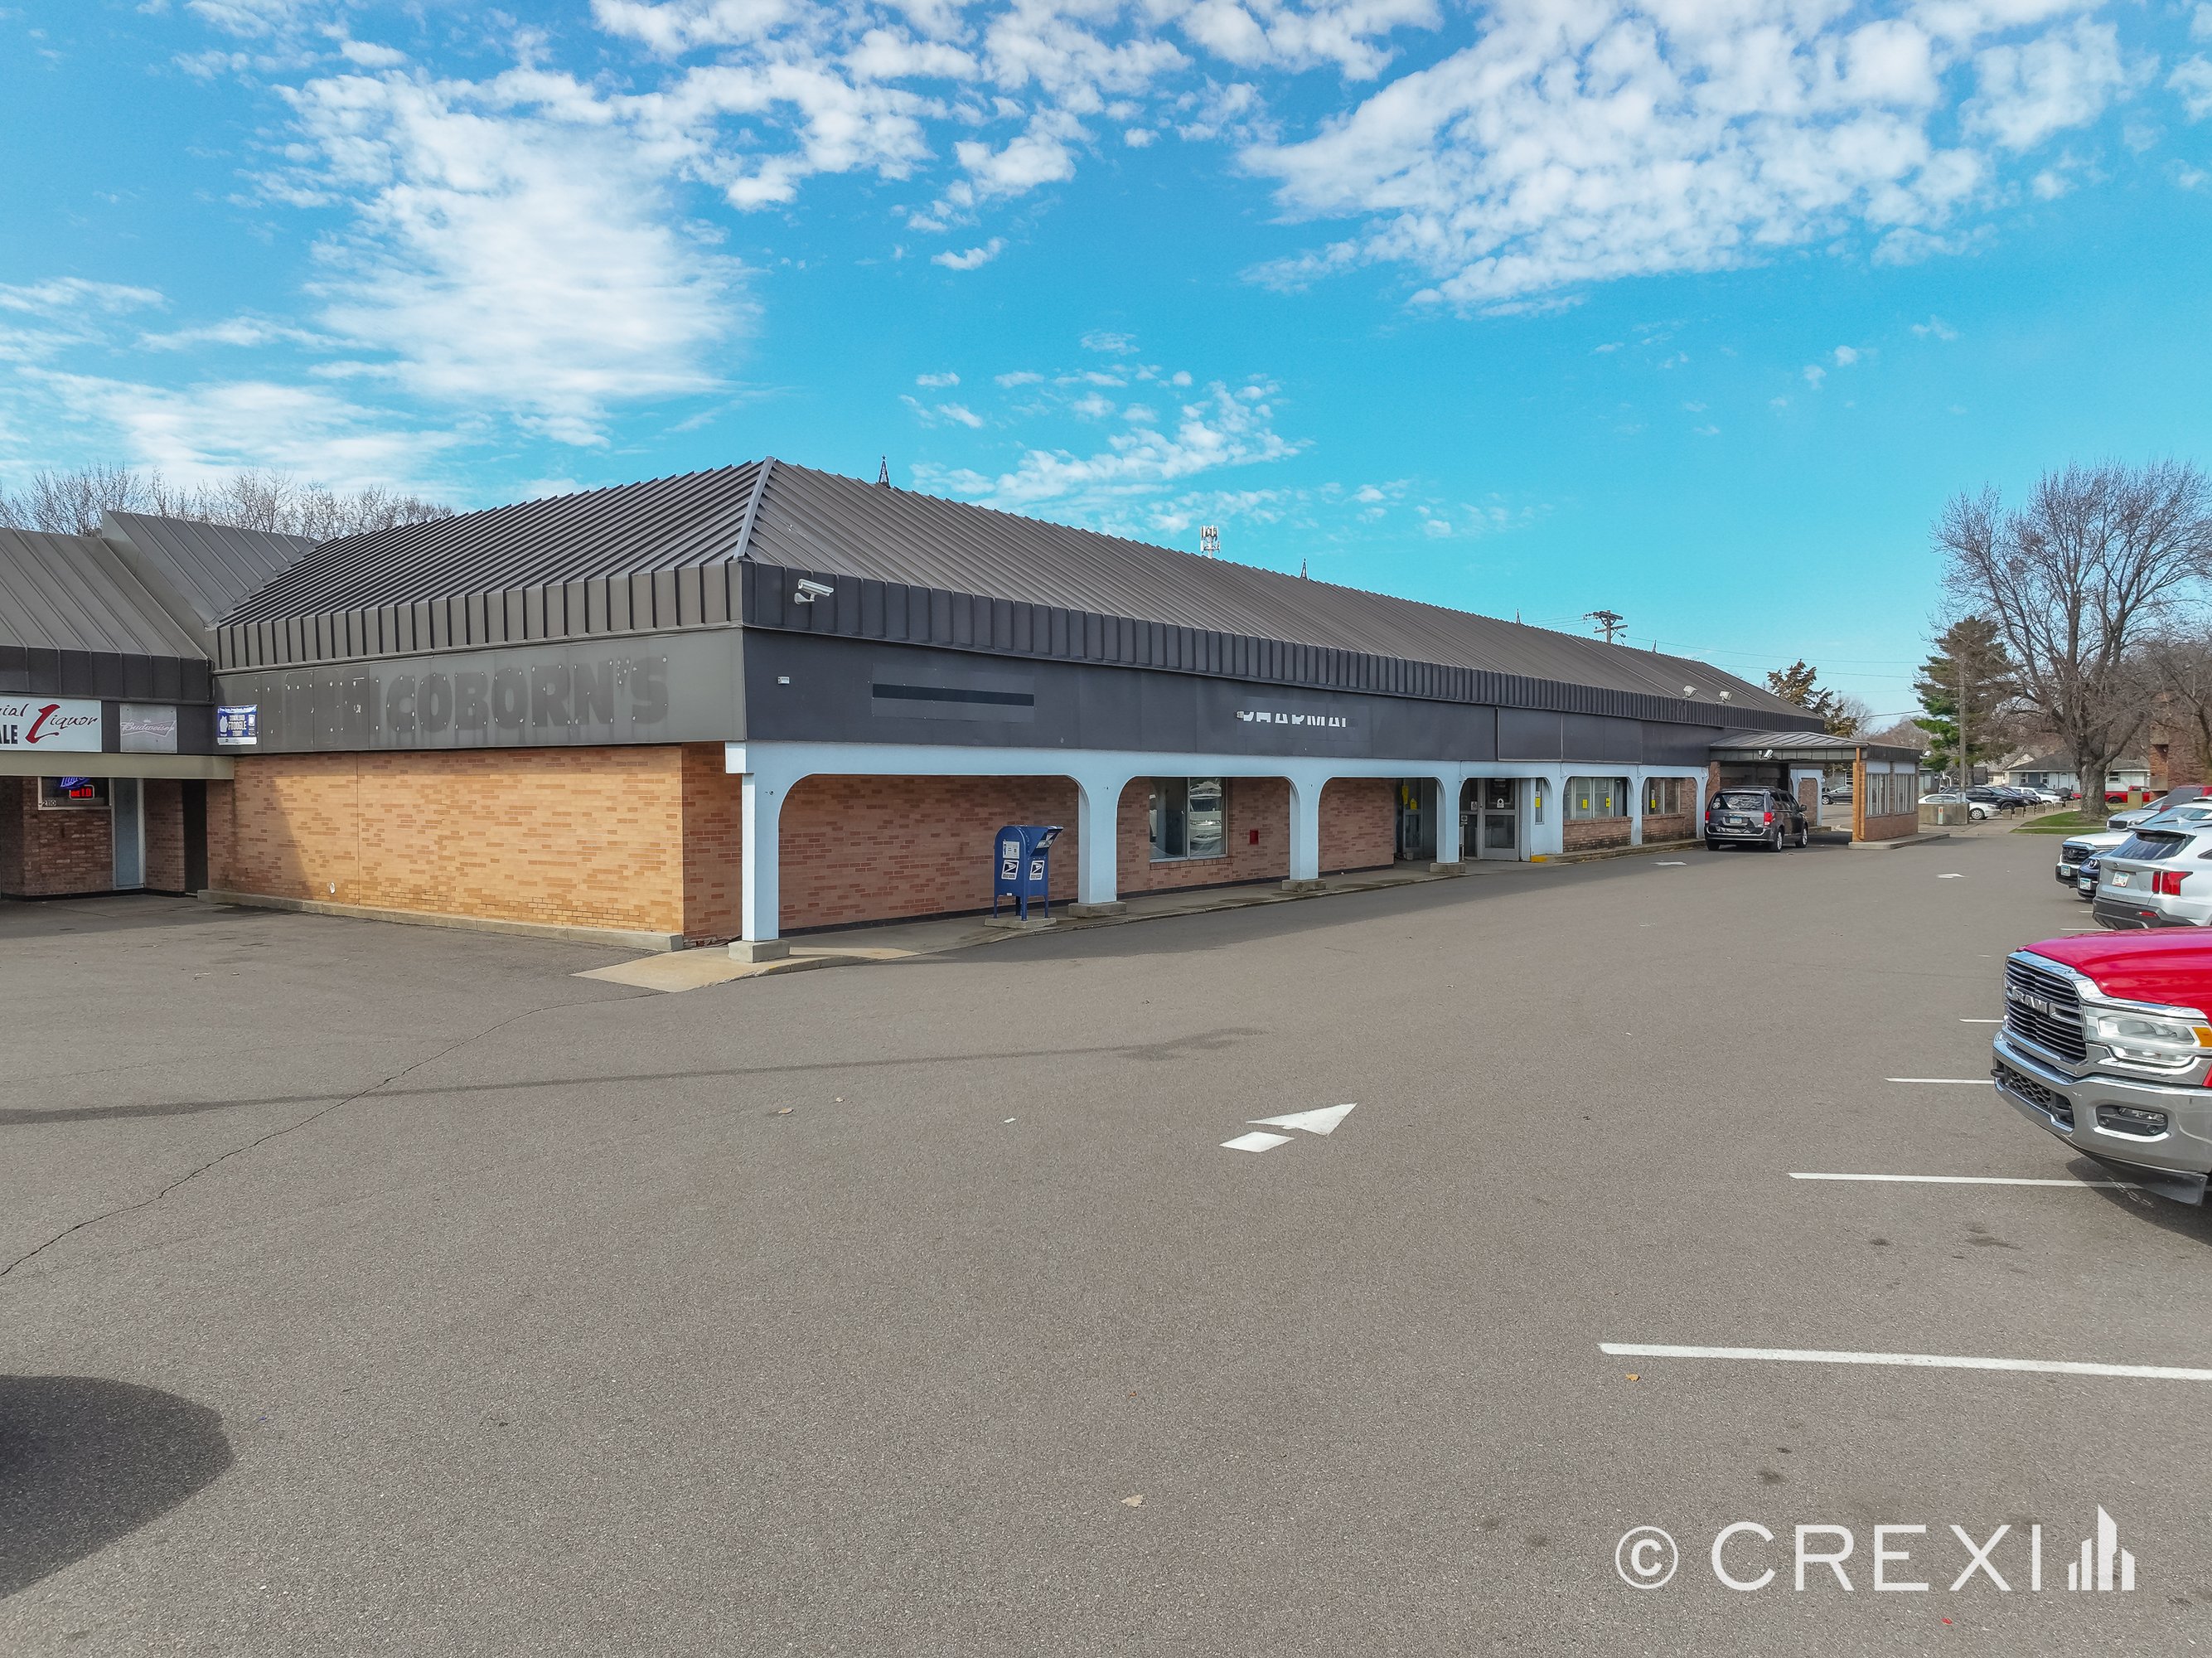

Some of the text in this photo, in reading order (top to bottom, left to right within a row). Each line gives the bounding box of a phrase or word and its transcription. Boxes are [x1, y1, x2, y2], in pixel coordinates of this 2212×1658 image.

[386, 656, 670, 733] COBORN'S
[0, 703, 98, 744] ial Liquor
[2013, 987, 2048, 1014] RAM
